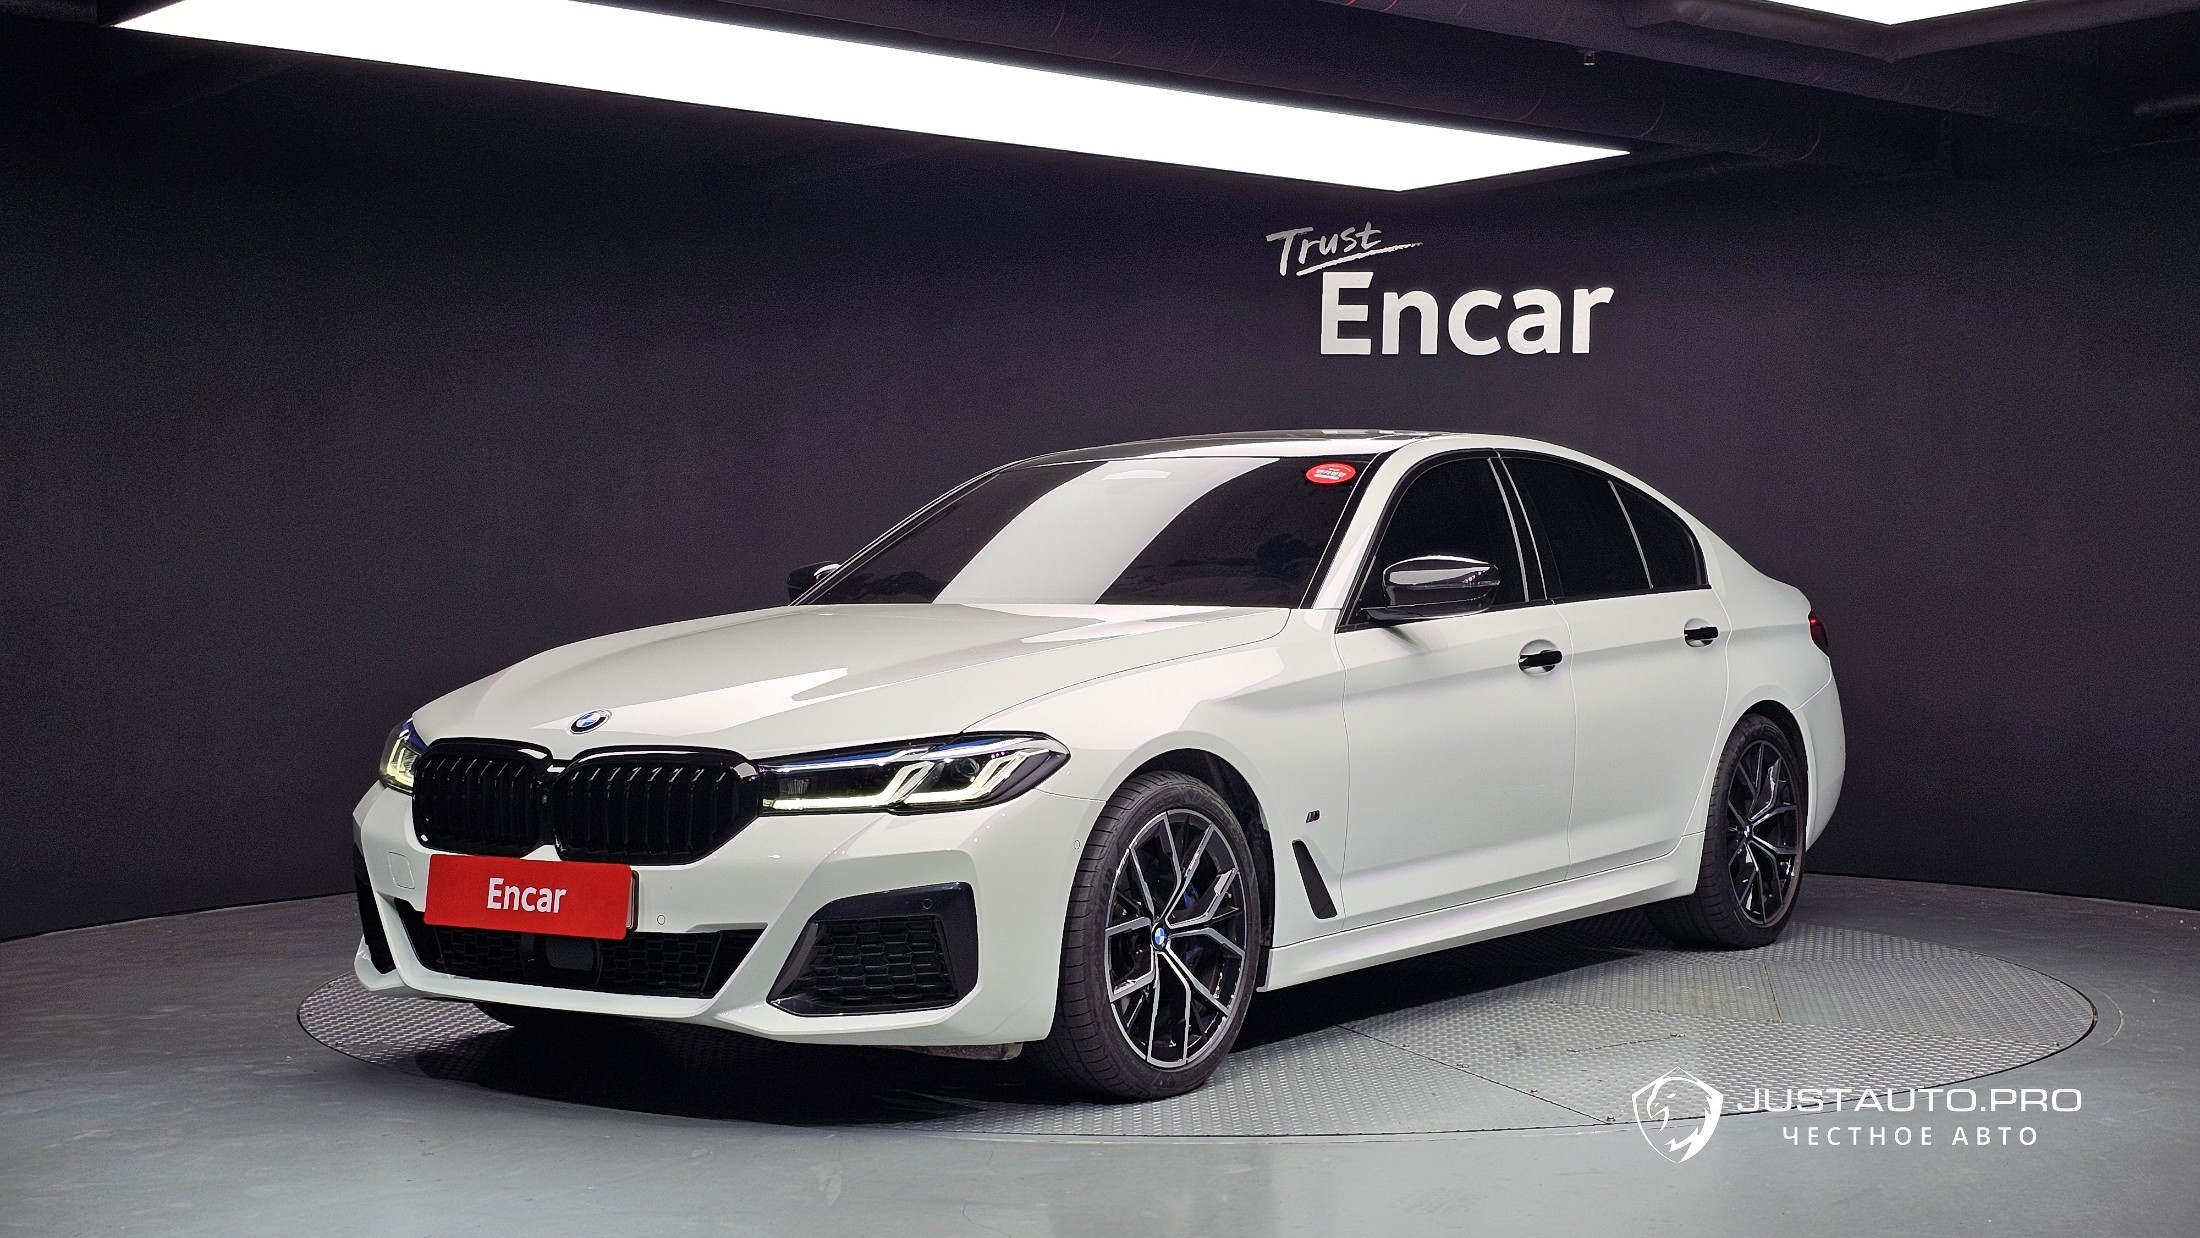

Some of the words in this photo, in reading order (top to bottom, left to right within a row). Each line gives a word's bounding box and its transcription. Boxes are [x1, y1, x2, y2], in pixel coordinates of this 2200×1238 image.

[1265, 221, 1382, 277] Trust
[1320, 271, 1615, 356] Encar
[486, 877, 567, 914] Encar
